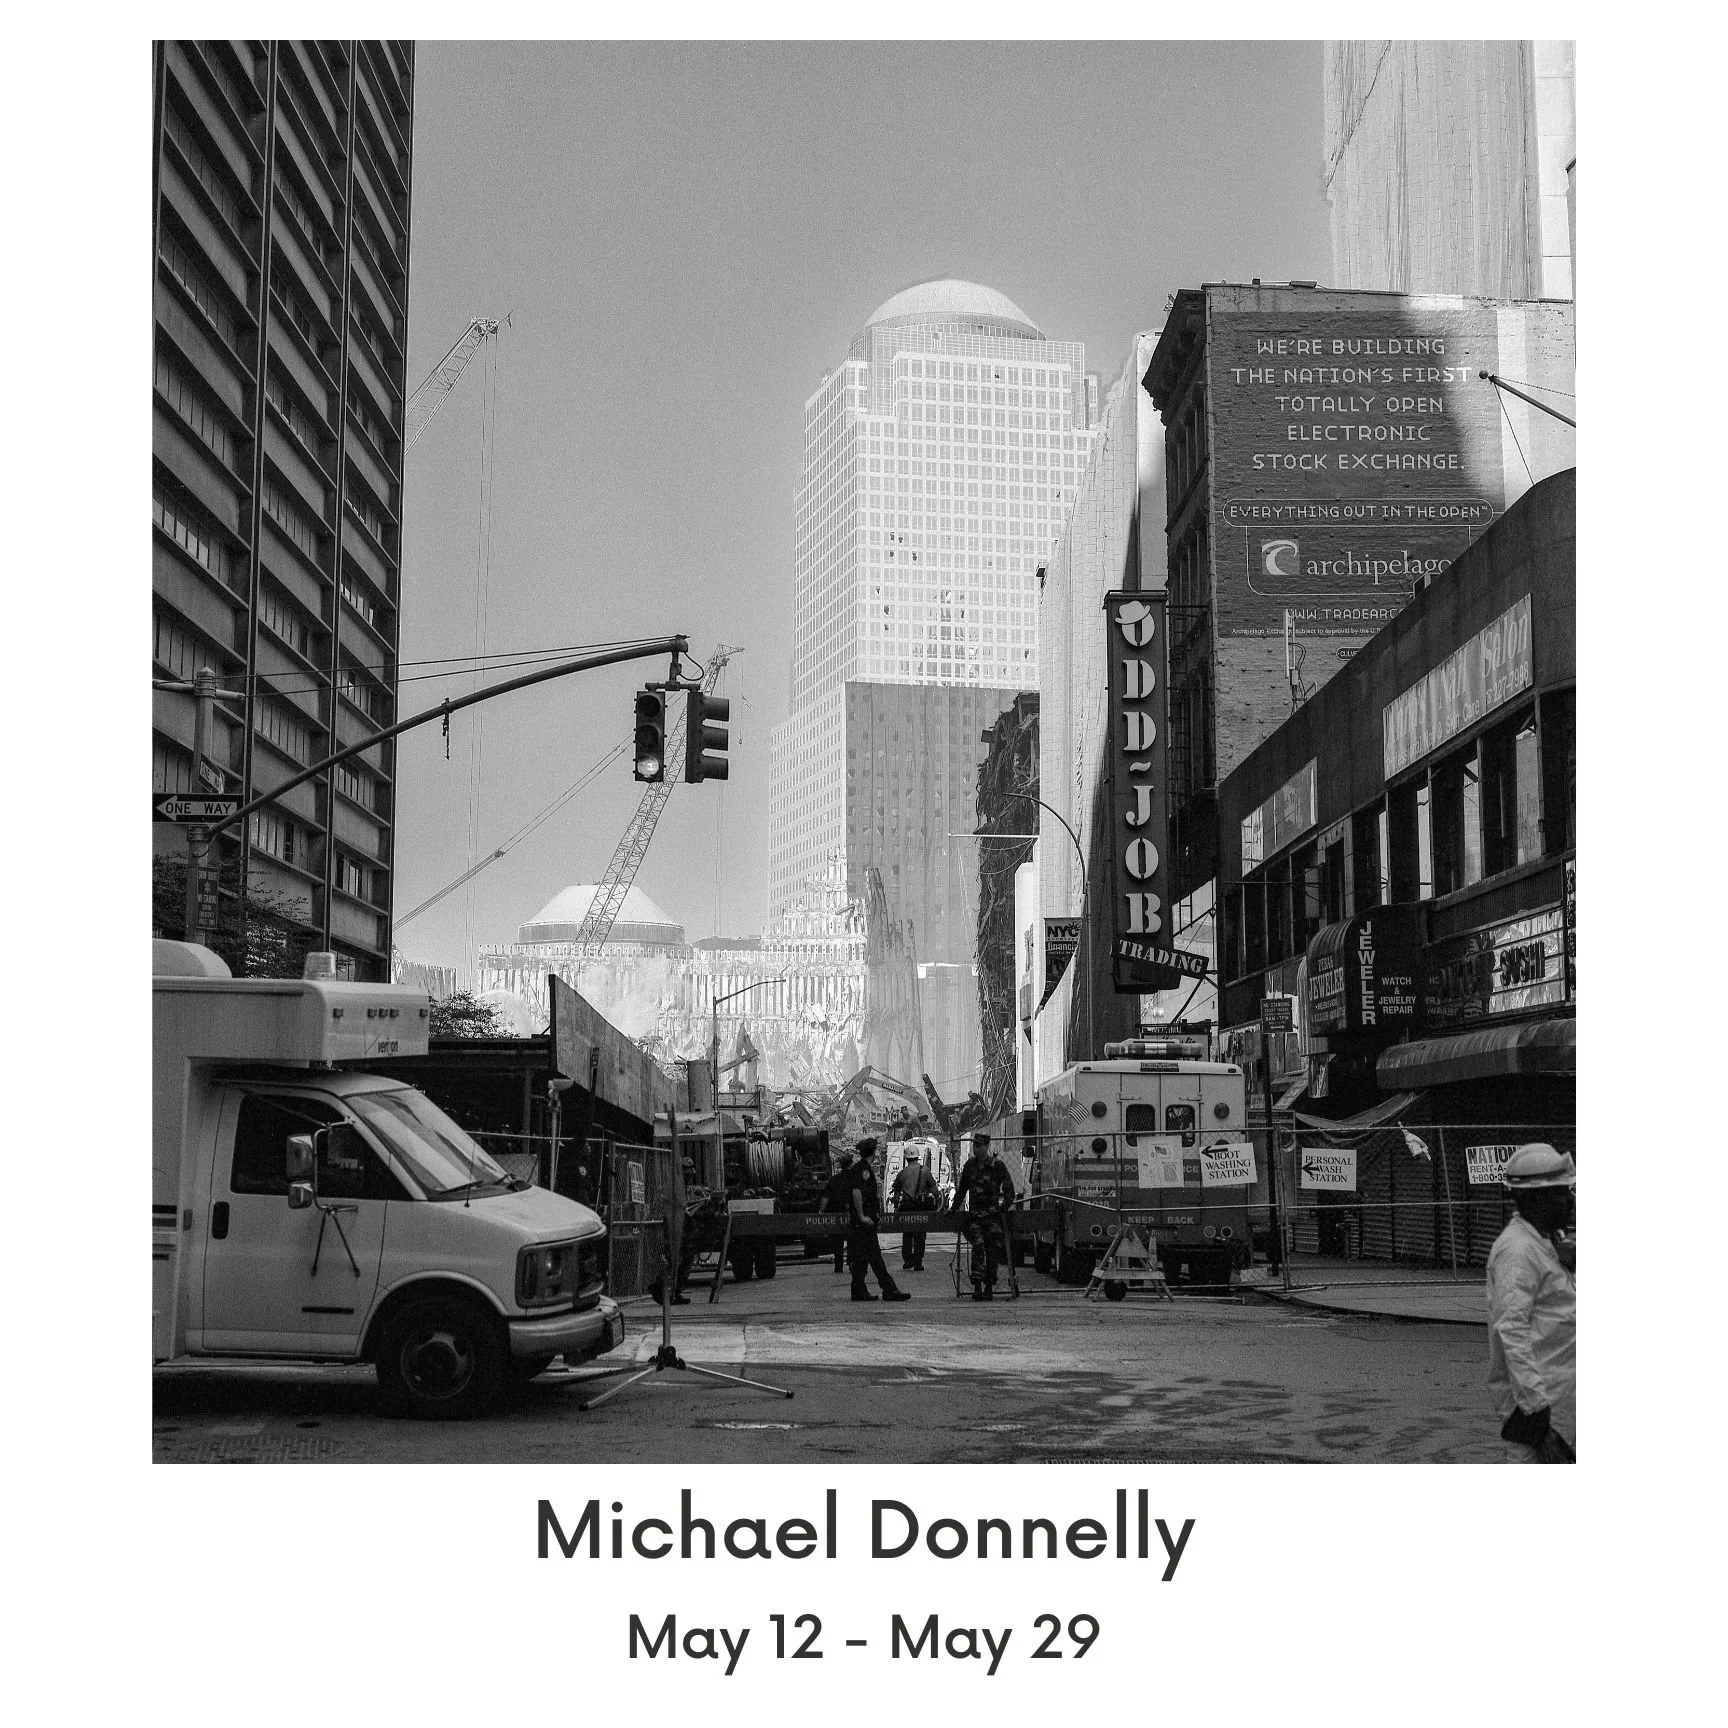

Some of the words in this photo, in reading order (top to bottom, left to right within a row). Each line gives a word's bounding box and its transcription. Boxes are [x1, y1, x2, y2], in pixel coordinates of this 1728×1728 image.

[1257, 338, 1323, 355] WE'RE
[1332, 338, 1445, 355] BUILDING
[1230, 368, 1275, 384] THE
[1284, 367, 1394, 384] NATION'S
[1402, 366, 1473, 383] FIRST
[1274, 396, 1376, 412] TOTALLY
[1386, 397, 1443, 413] OPEN
[1287, 425, 1433, 441] ELECTRONIC
[1252, 453, 1328, 470] STOCK
[1338, 453, 1465, 470] EXCHANGE.
[1230, 505, 1340, 518] EVERYTHING
[1343, 505, 1377, 518] OUT
[1381, 505, 1401, 518] IN
[1404, 505, 1436, 518] THE
[1481, 613, 1528, 678] Salon
[165, 802, 192, 814] ONE
[203, 802, 232, 815] WAY
[1047, 922, 1080, 938] NYC
[1119, 939, 1204, 974] TRADING
[1357, 920, 1376, 1025] JEWELER
[1308, 966, 1345, 1001] JEWELER
[1381, 976, 1412, 986] WATCH
[1394, 986, 1400, 995] &
[1378, 995, 1417, 1005] JEWELRY
[1382, 1005, 1413, 1015] REPAIR
[1213, 1150, 1240, 1160] BOOT
[1305, 1155, 1353, 1166] PERSONAL
[1205, 1159, 1251, 1171] WASHING
[1318, 1165, 1342, 1174] WASH
[1209, 1169, 1249, 1180] STATION
[1309, 1173, 1348, 1183] STATION
[806, 1217, 836, 1225] POLICE
[900, 1215, 929, 1224] CROSS
[1127, 1216, 1155, 1224] KEEP
[1167, 1216, 1195, 1225] BACK
